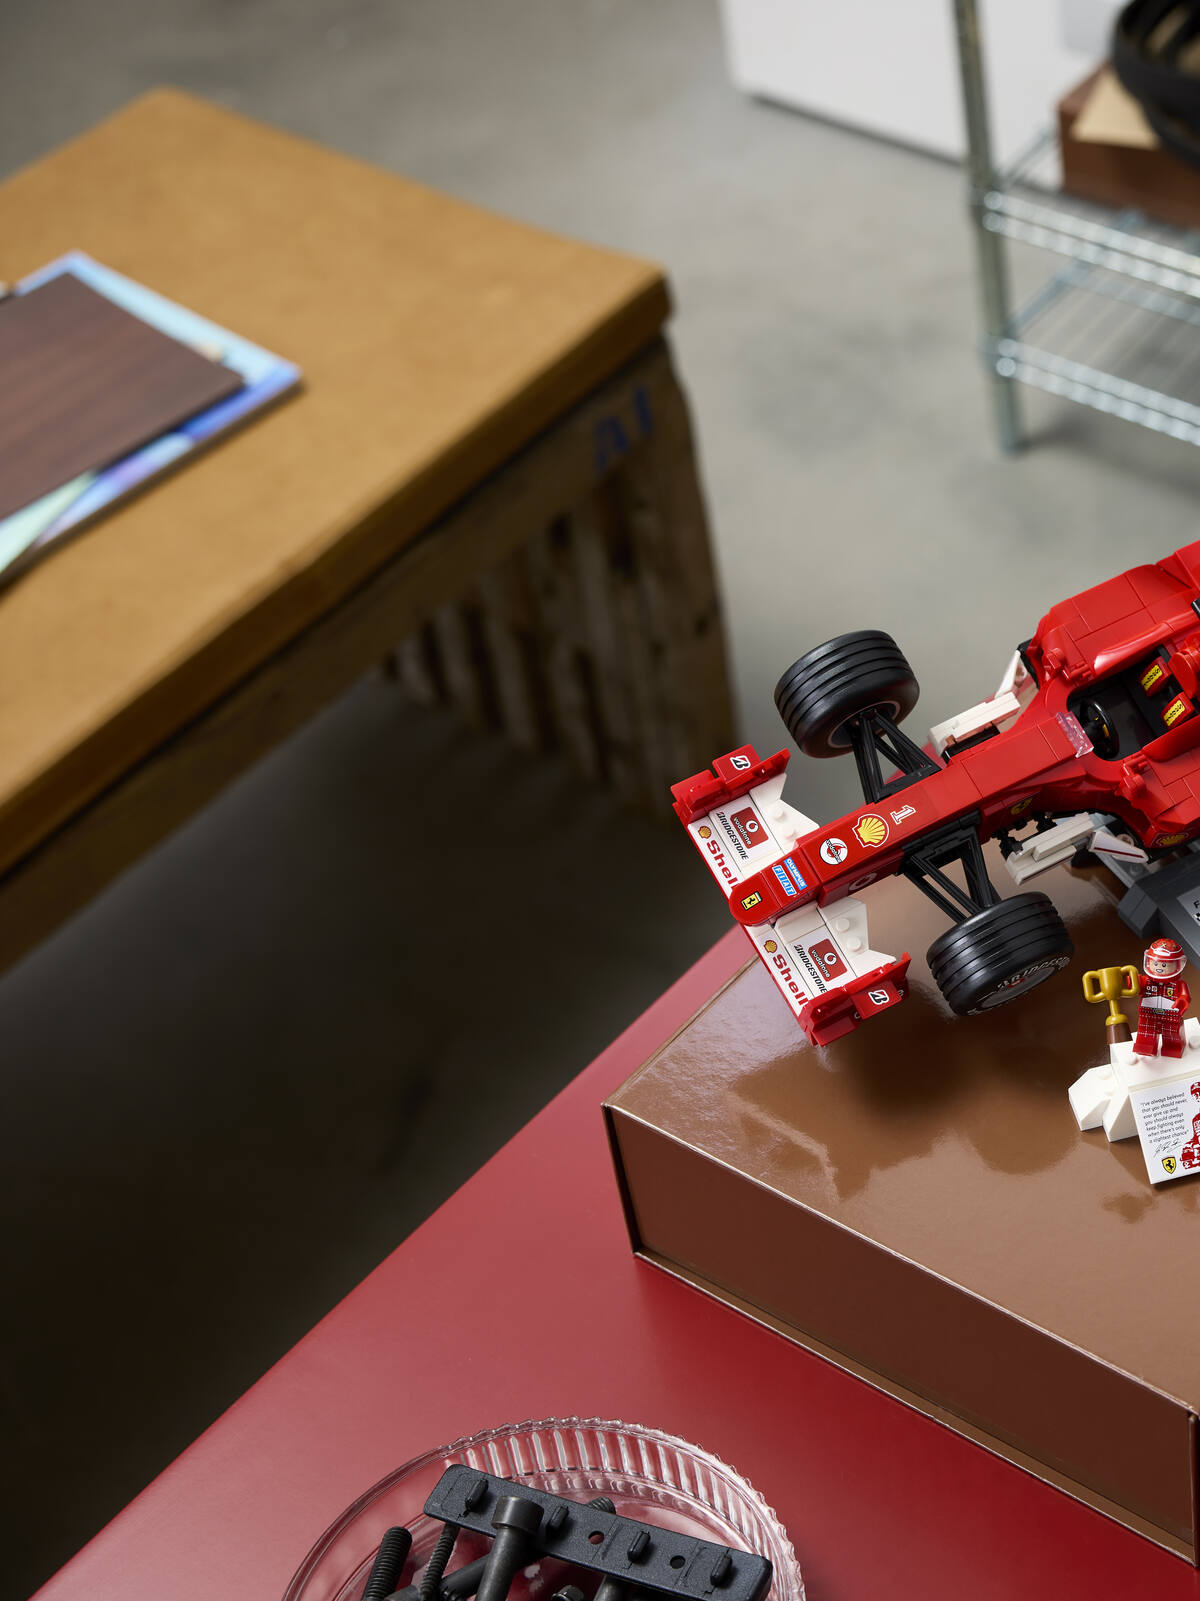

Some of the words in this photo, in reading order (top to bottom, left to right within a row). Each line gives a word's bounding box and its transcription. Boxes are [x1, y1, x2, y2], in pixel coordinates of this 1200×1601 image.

[717, 812, 749, 860] BRIDGESTONE
[733, 816, 751, 846] vodafone
[773, 866, 796, 895] FIAT
[786, 858, 806, 888] OLYMPUS
[794, 944, 827, 993] BRIDGESTONE
[811, 949, 830, 978] vodafone
[774, 954, 808, 1005] Shell
[1169, 1113, 1183, 1121] always
